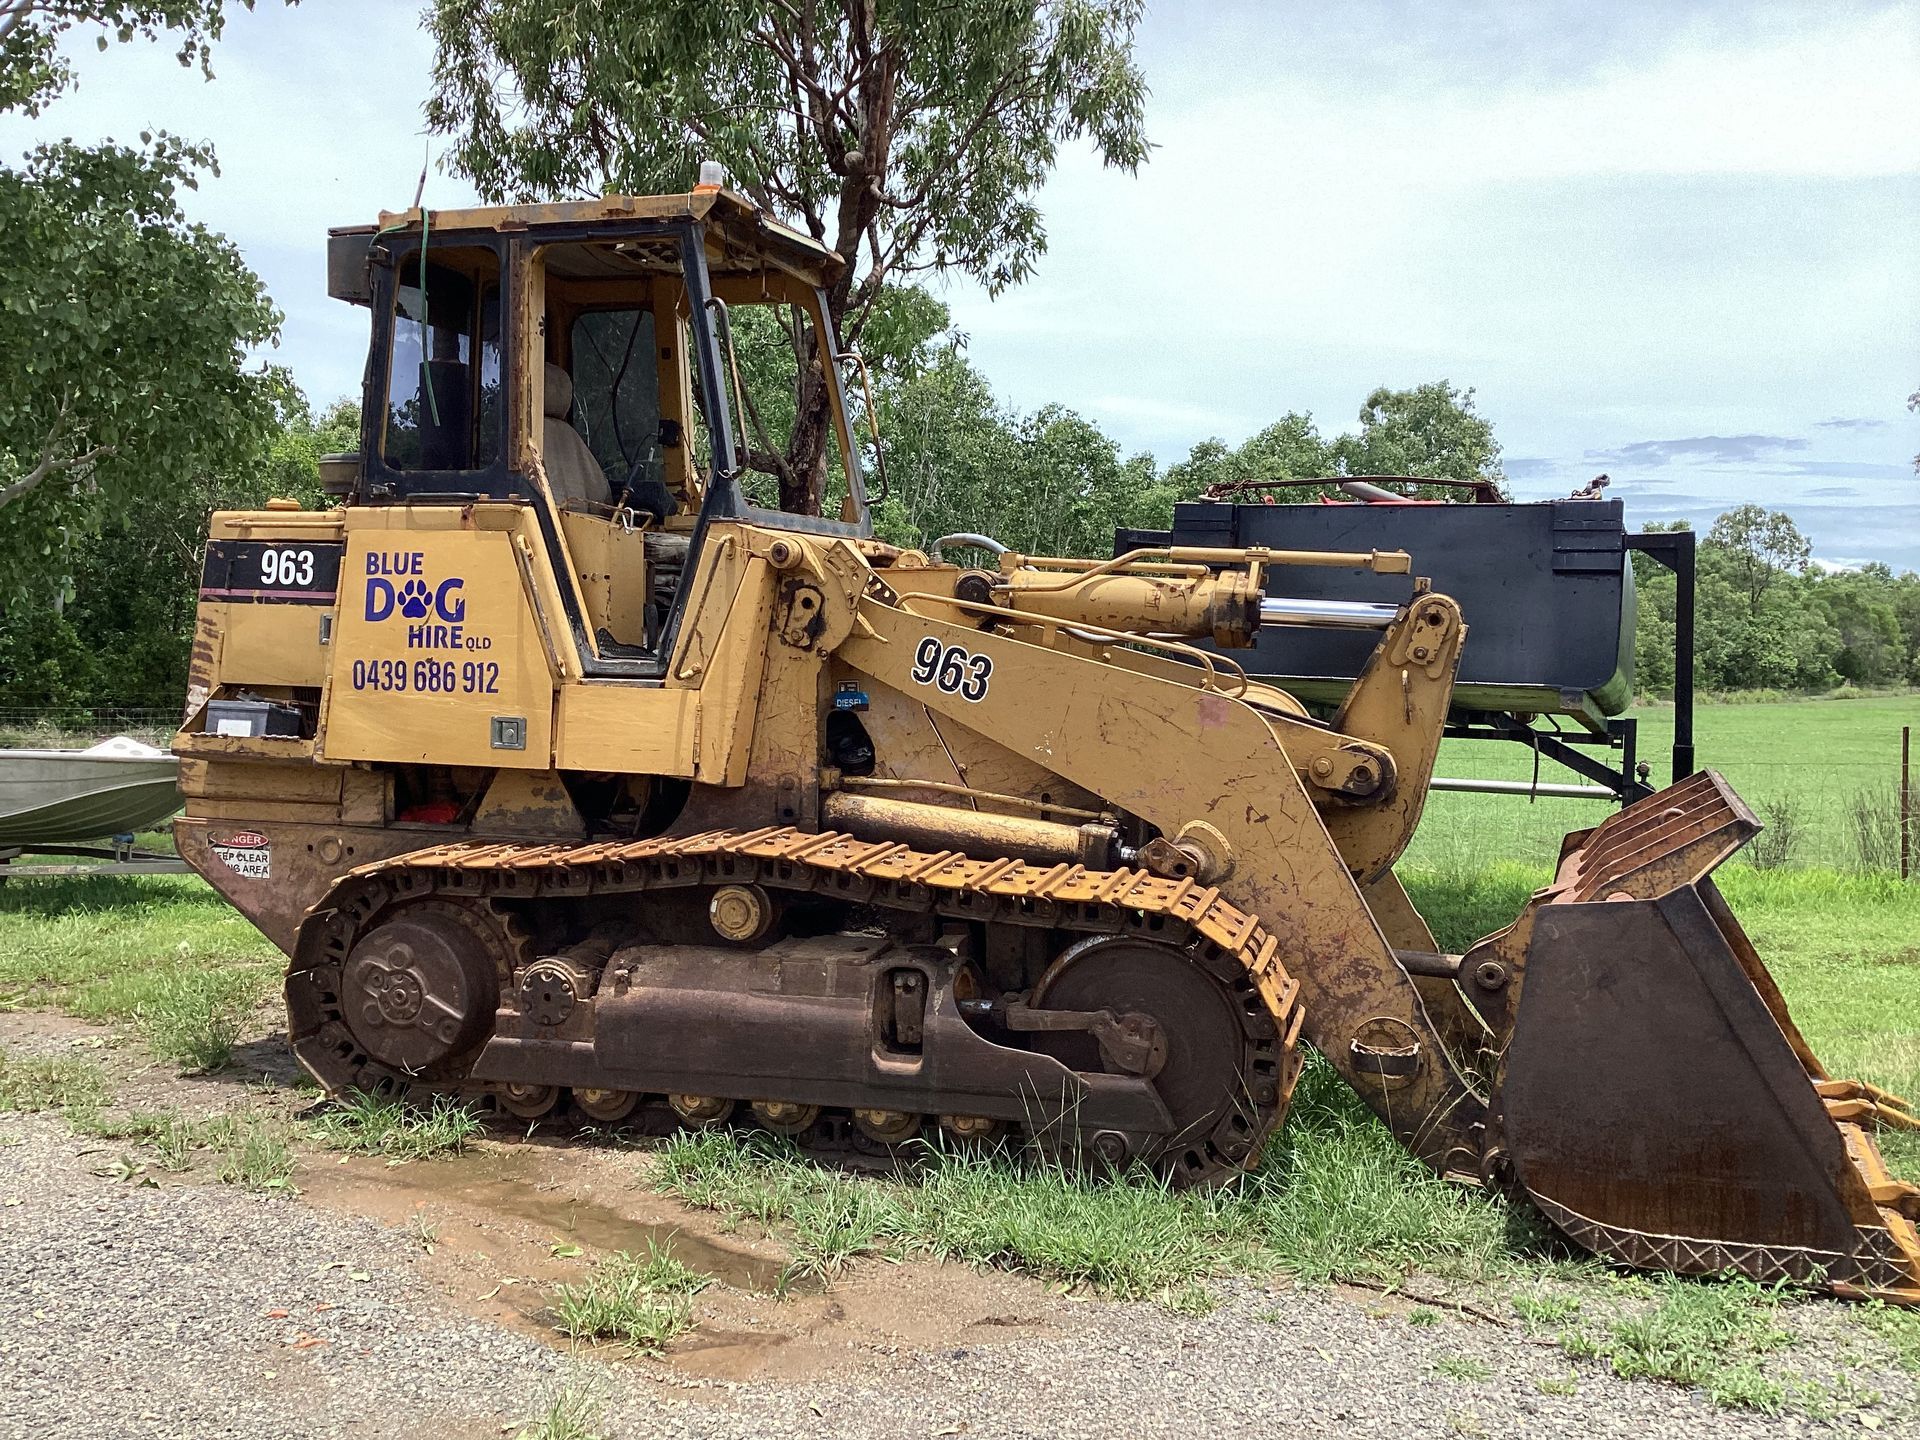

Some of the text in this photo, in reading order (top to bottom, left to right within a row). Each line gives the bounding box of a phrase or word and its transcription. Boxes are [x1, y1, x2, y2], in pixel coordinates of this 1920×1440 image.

[260, 549, 314, 586] 963
[365, 552, 424, 575] BLUE
[408, 625, 492, 652] HIRE QLD
[353, 659, 500, 694] 0439 686 912
[911, 636, 994, 703] 963
[236, 853, 269, 863] CLEAR
[242, 864, 269, 875] AREA
